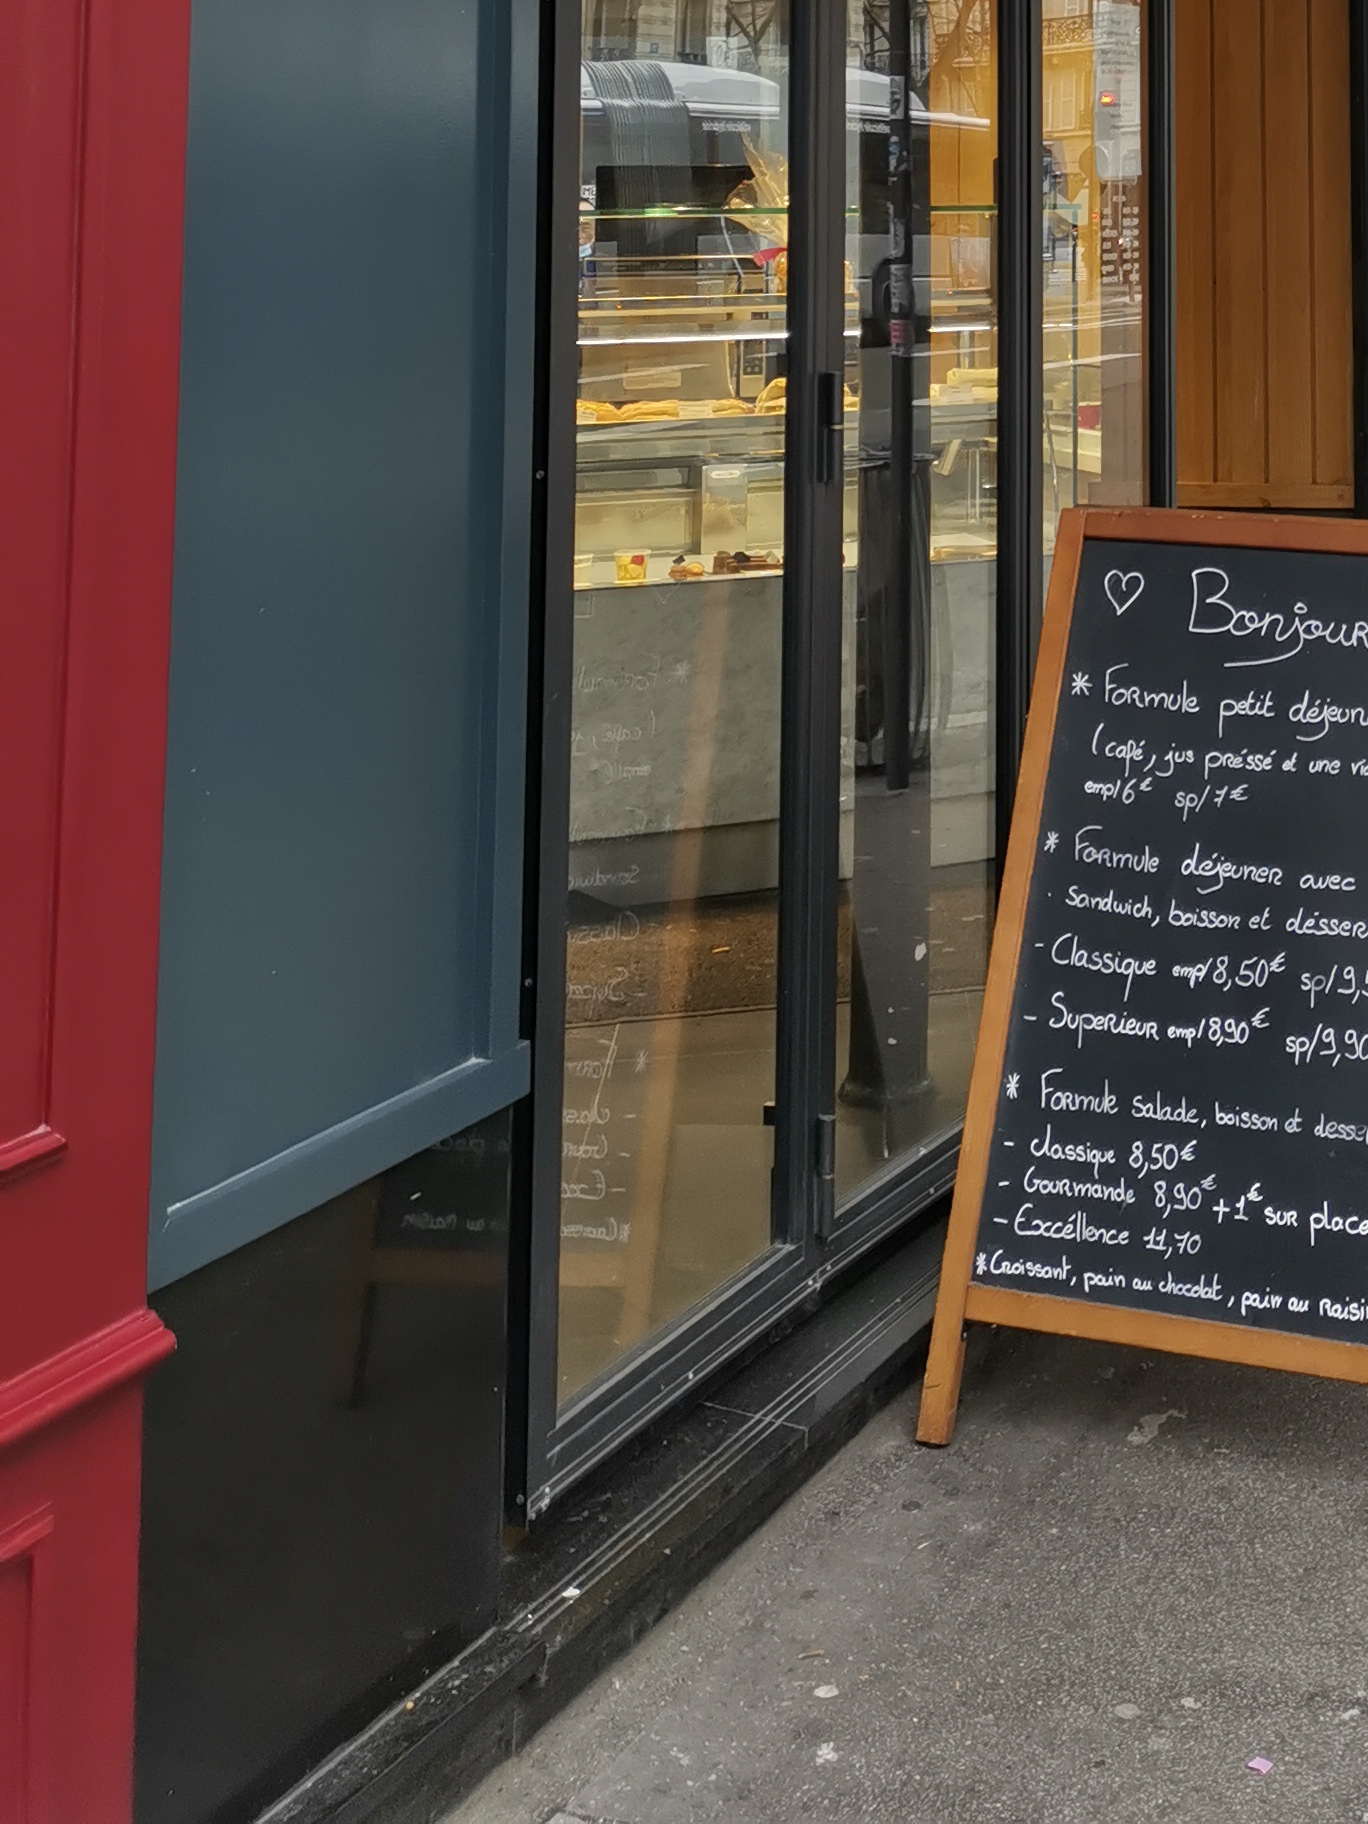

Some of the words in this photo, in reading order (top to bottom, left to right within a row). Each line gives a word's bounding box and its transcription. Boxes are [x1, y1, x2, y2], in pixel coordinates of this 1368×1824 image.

[1105, 663, 1200, 713] Formule
[1219, 691, 1275, 738] petit
[1159, 750, 1194, 777] jus
[1282, 752, 1297, 772] et
[1309, 760, 1341, 774] une
[1075, 825, 1159, 873] Formule
[1181, 842, 1282, 894] déjeuner
[1300, 874, 1356, 891] avec
[1065, 885, 1160, 927] Sandwich,
[1168, 899, 1241, 929] boisson
[1249, 907, 1271, 930] et
[1051, 933, 1157, 1002] Classique
[1041, 1068, 1118, 1114] Formule
[1215, 1101, 1278, 1131] boisson
[1284, 1108, 1303, 1133] et
[1030, 1124, 1116, 1179] Classique
[1129, 1140, 1197, 1179] 8,50€
[1024, 1165, 1135, 1207] Gourmande
[1154, 1174, 1217, 1219] 8,90€
[1264, 1206, 1298, 1227] sur
[1083, 1268, 1126, 1292] pain
[1132, 1278, 1153, 1290] au
[1241, 1291, 1283, 1316] pain
[1288, 1297, 1309, 1312] au
